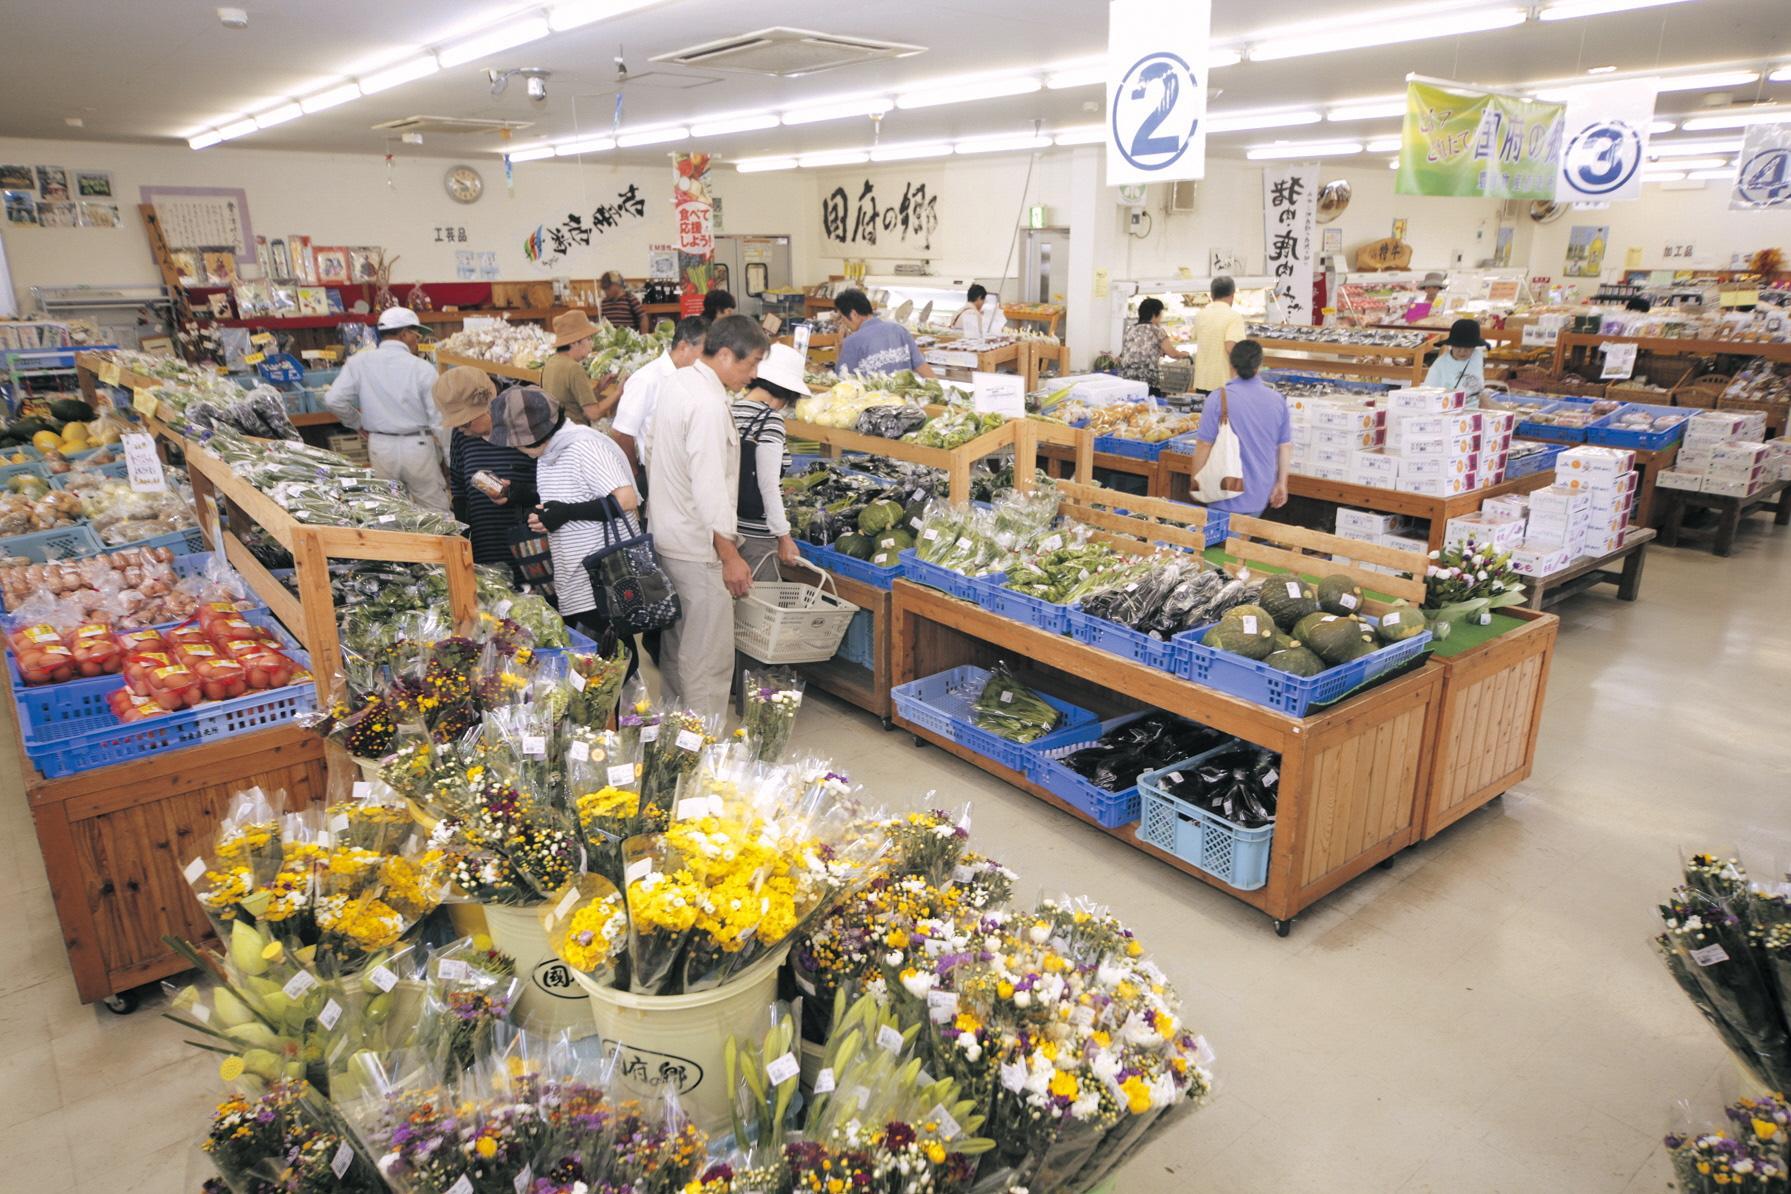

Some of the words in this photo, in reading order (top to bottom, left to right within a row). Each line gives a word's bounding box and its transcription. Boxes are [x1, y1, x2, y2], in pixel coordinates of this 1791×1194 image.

[679, 207, 710, 222] 食べて
[822, 178, 939, 251] 国府の郷
[434, 227, 468, 242] 工芸品
[679, 222, 702, 235] 応援
[679, 235, 712, 249] しよう!
[1663, 245, 1694, 258] 加工品
